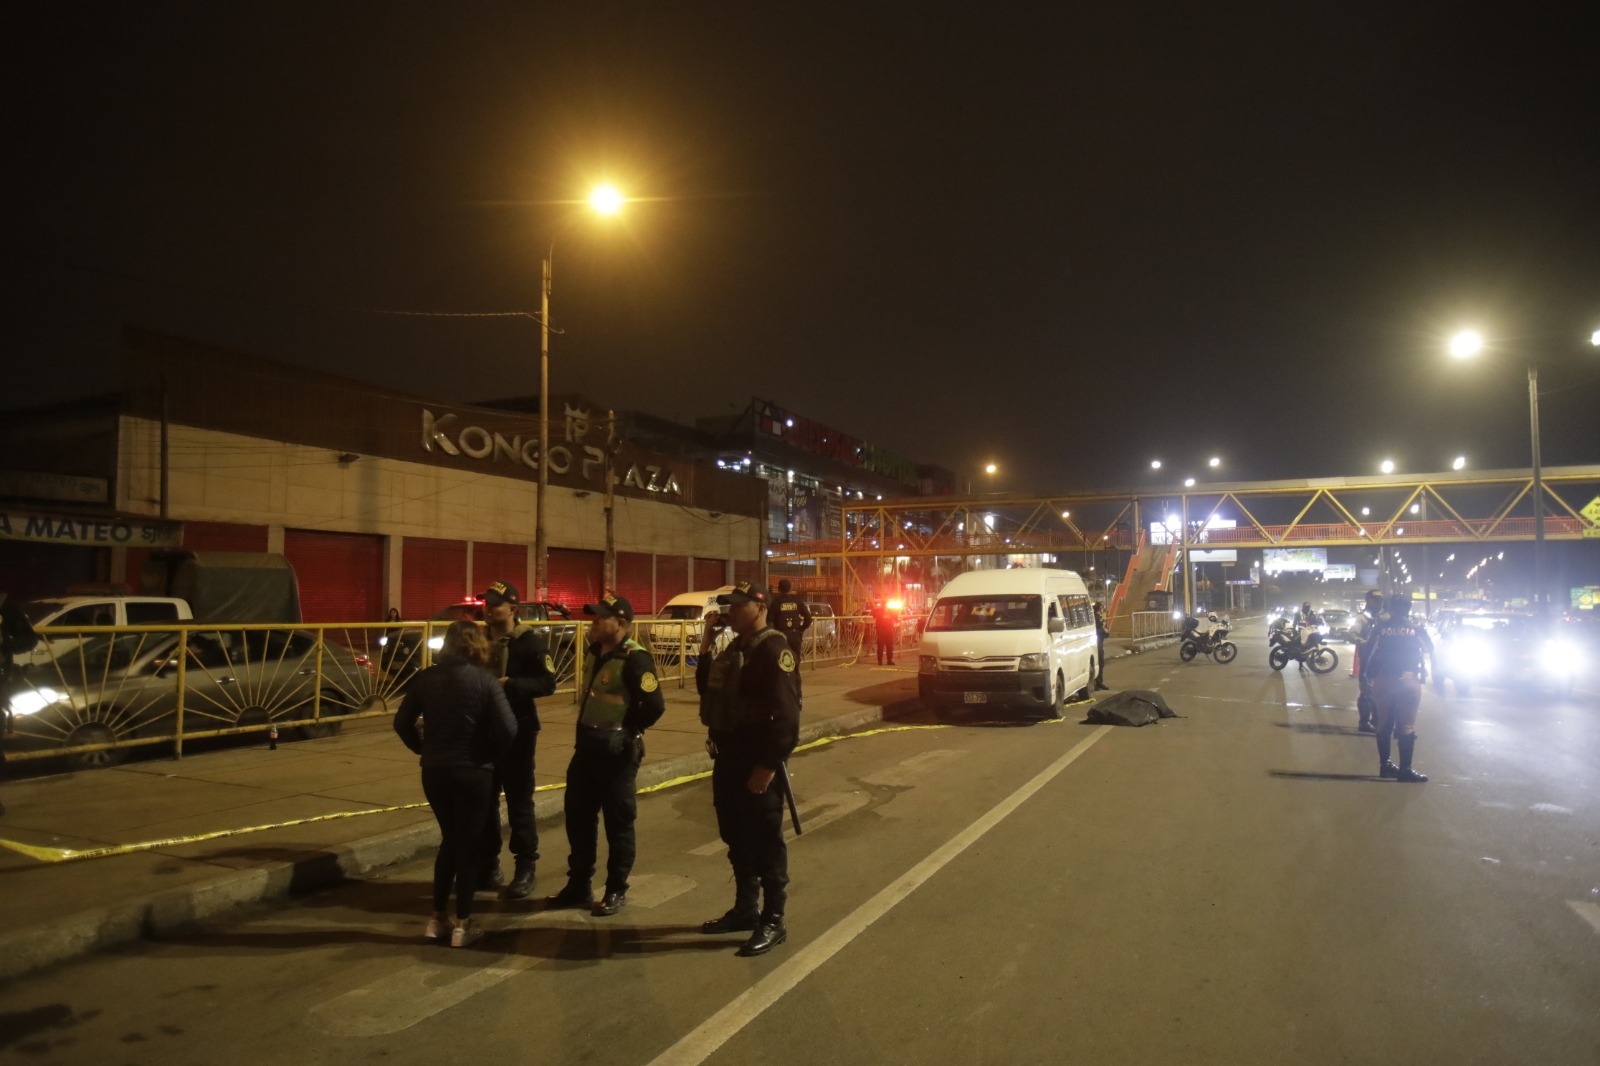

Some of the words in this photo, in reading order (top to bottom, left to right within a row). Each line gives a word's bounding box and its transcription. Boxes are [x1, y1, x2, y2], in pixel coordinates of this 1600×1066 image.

[421, 409, 573, 474] KONGO
[582, 445, 683, 497] PAZA
[25, 516, 133, 543] MATEO
[1381, 627, 1416, 637] POLICIA
